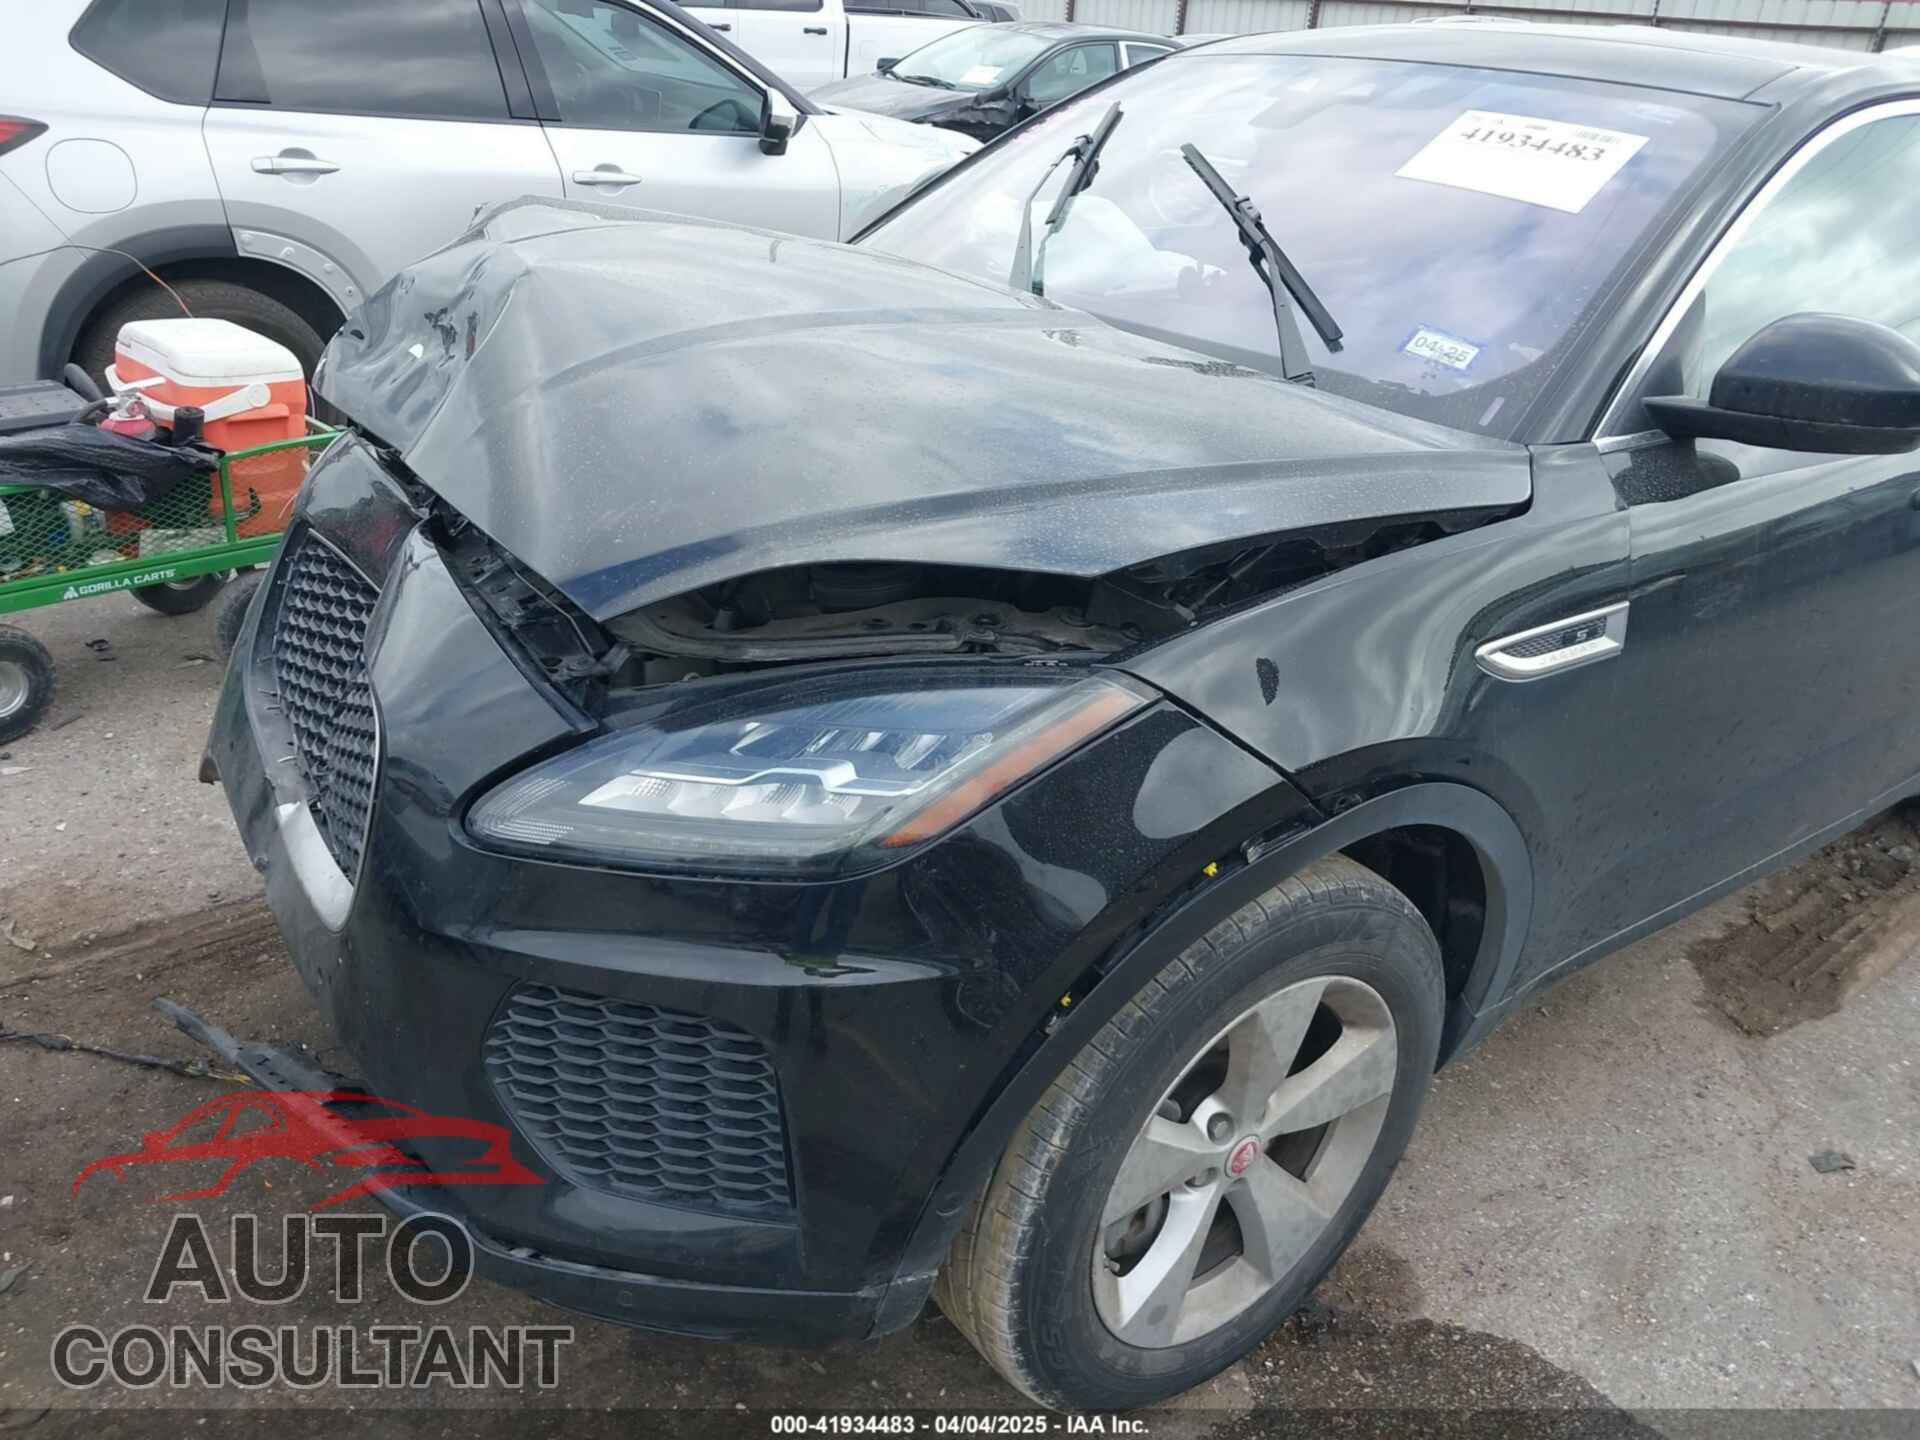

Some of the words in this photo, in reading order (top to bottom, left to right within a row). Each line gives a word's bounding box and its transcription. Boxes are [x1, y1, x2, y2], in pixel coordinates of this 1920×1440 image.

[1461, 128, 1605, 161] 41934483
[79, 578, 131, 595] GORILLA
[134, 569, 176, 584] CARTS
